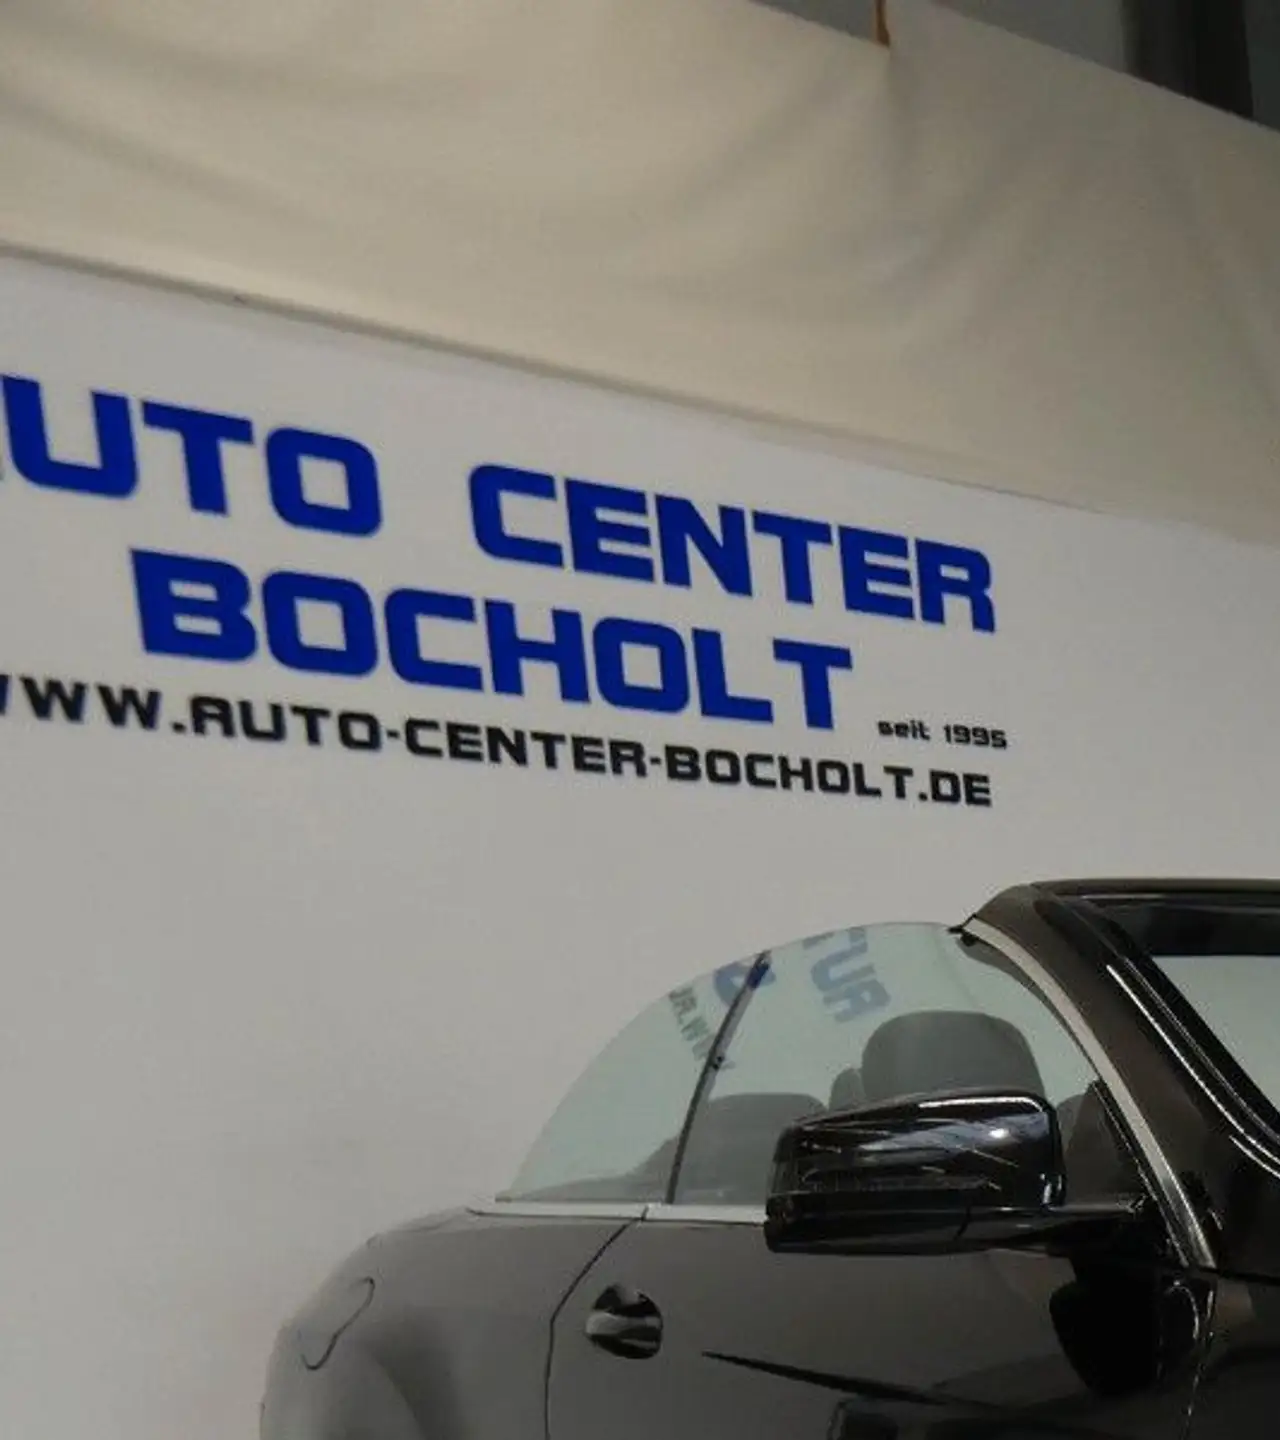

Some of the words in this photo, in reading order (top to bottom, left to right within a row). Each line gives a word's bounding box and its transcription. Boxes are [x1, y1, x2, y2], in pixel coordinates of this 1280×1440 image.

[0, 374, 383, 538] UTO
[470, 465, 996, 633] CENTER
[132, 549, 853, 730] BOCHOLT
[0, 673, 992, 808] WW.AUTO-CENTER-BOCHOLT.DE
[877, 719, 931, 742] seit
[943, 724, 1008, 750] 1995
